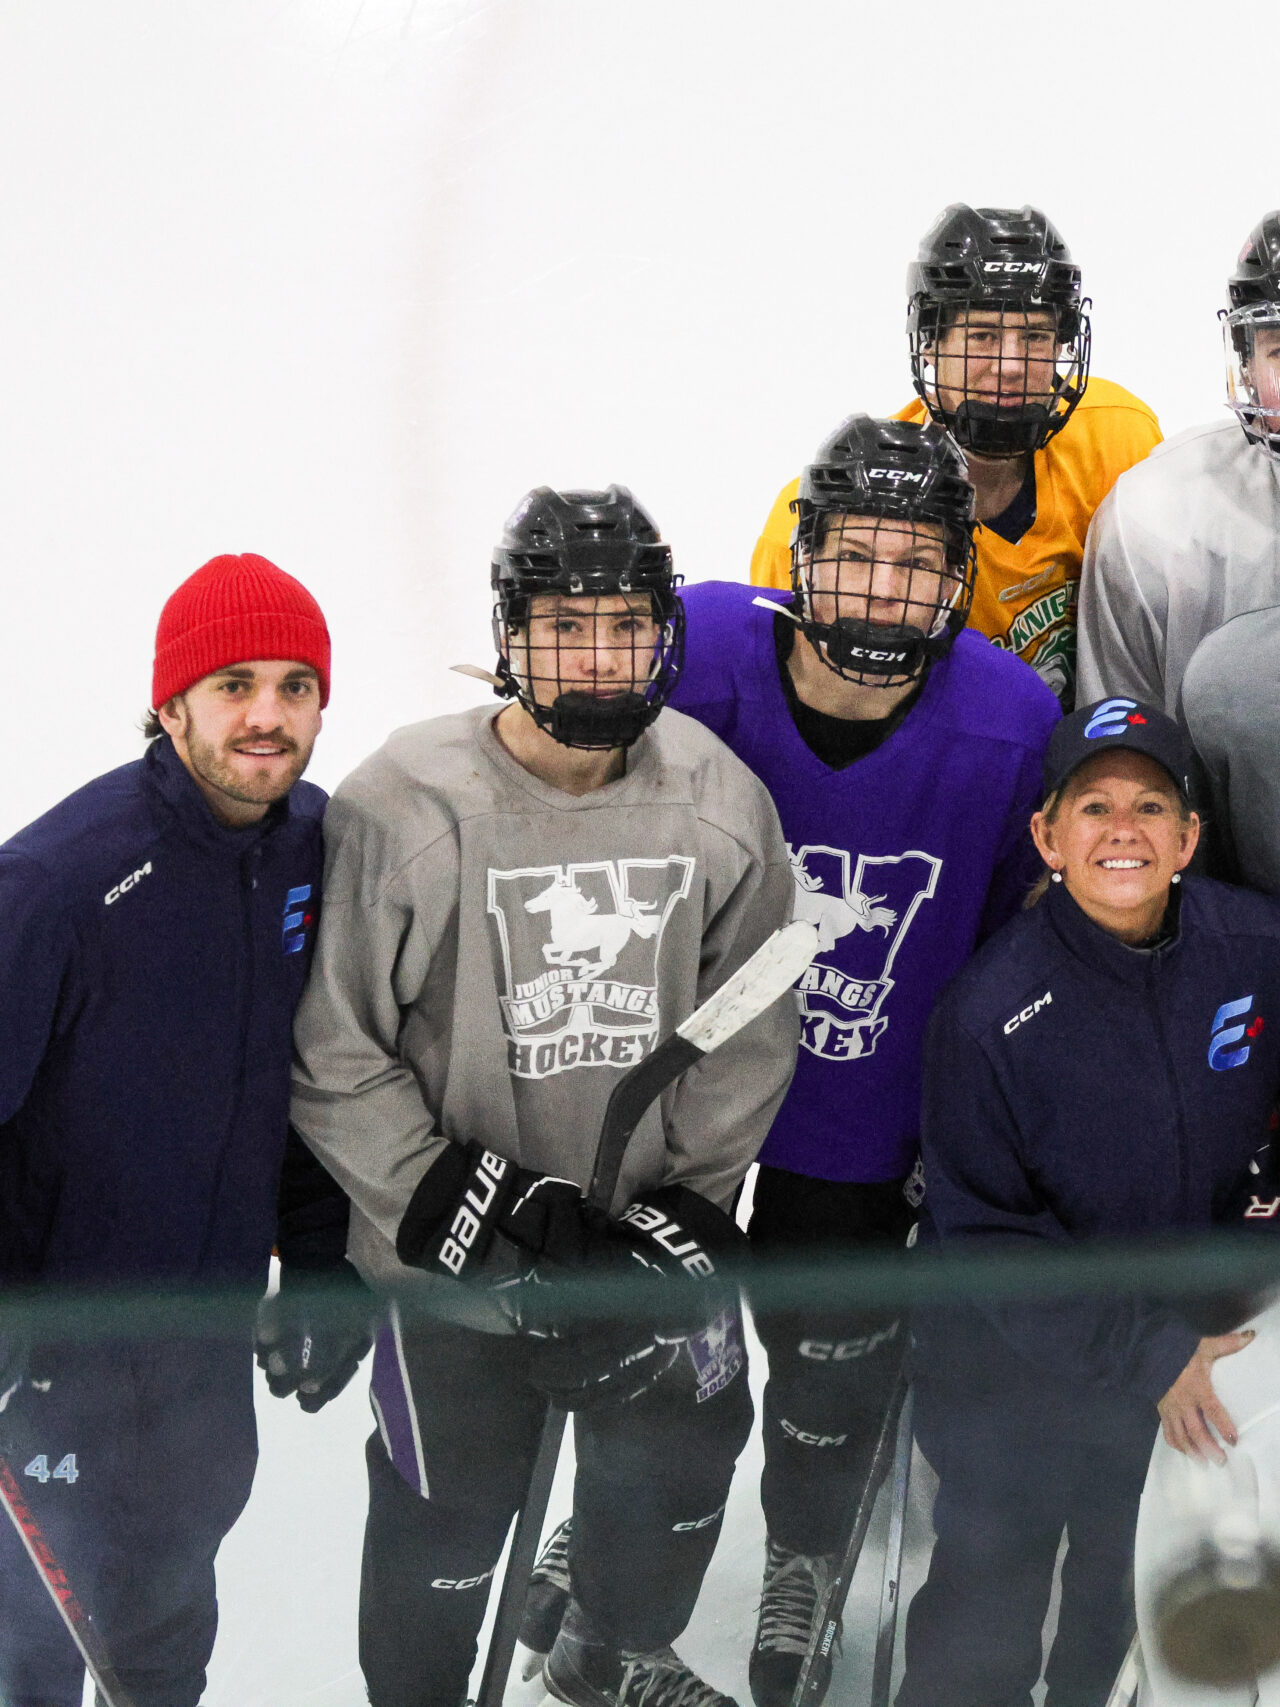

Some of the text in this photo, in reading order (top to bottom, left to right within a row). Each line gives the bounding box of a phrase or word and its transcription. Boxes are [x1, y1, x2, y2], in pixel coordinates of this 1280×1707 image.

[983, 261, 1042, 275] CCM
[869, 467, 922, 483] CCM
[104, 861, 153, 906] CCM
[514, 968, 575, 1000] JUNIOR
[509, 982, 658, 1027] MUSTANGS
[1003, 991, 1053, 1035] CCM
[506, 1031, 660, 1075] HOCKEY
[798, 1320, 900, 1361] CCM
[780, 1418, 849, 1447] CCM
[23, 1453, 79, 1484] 44
